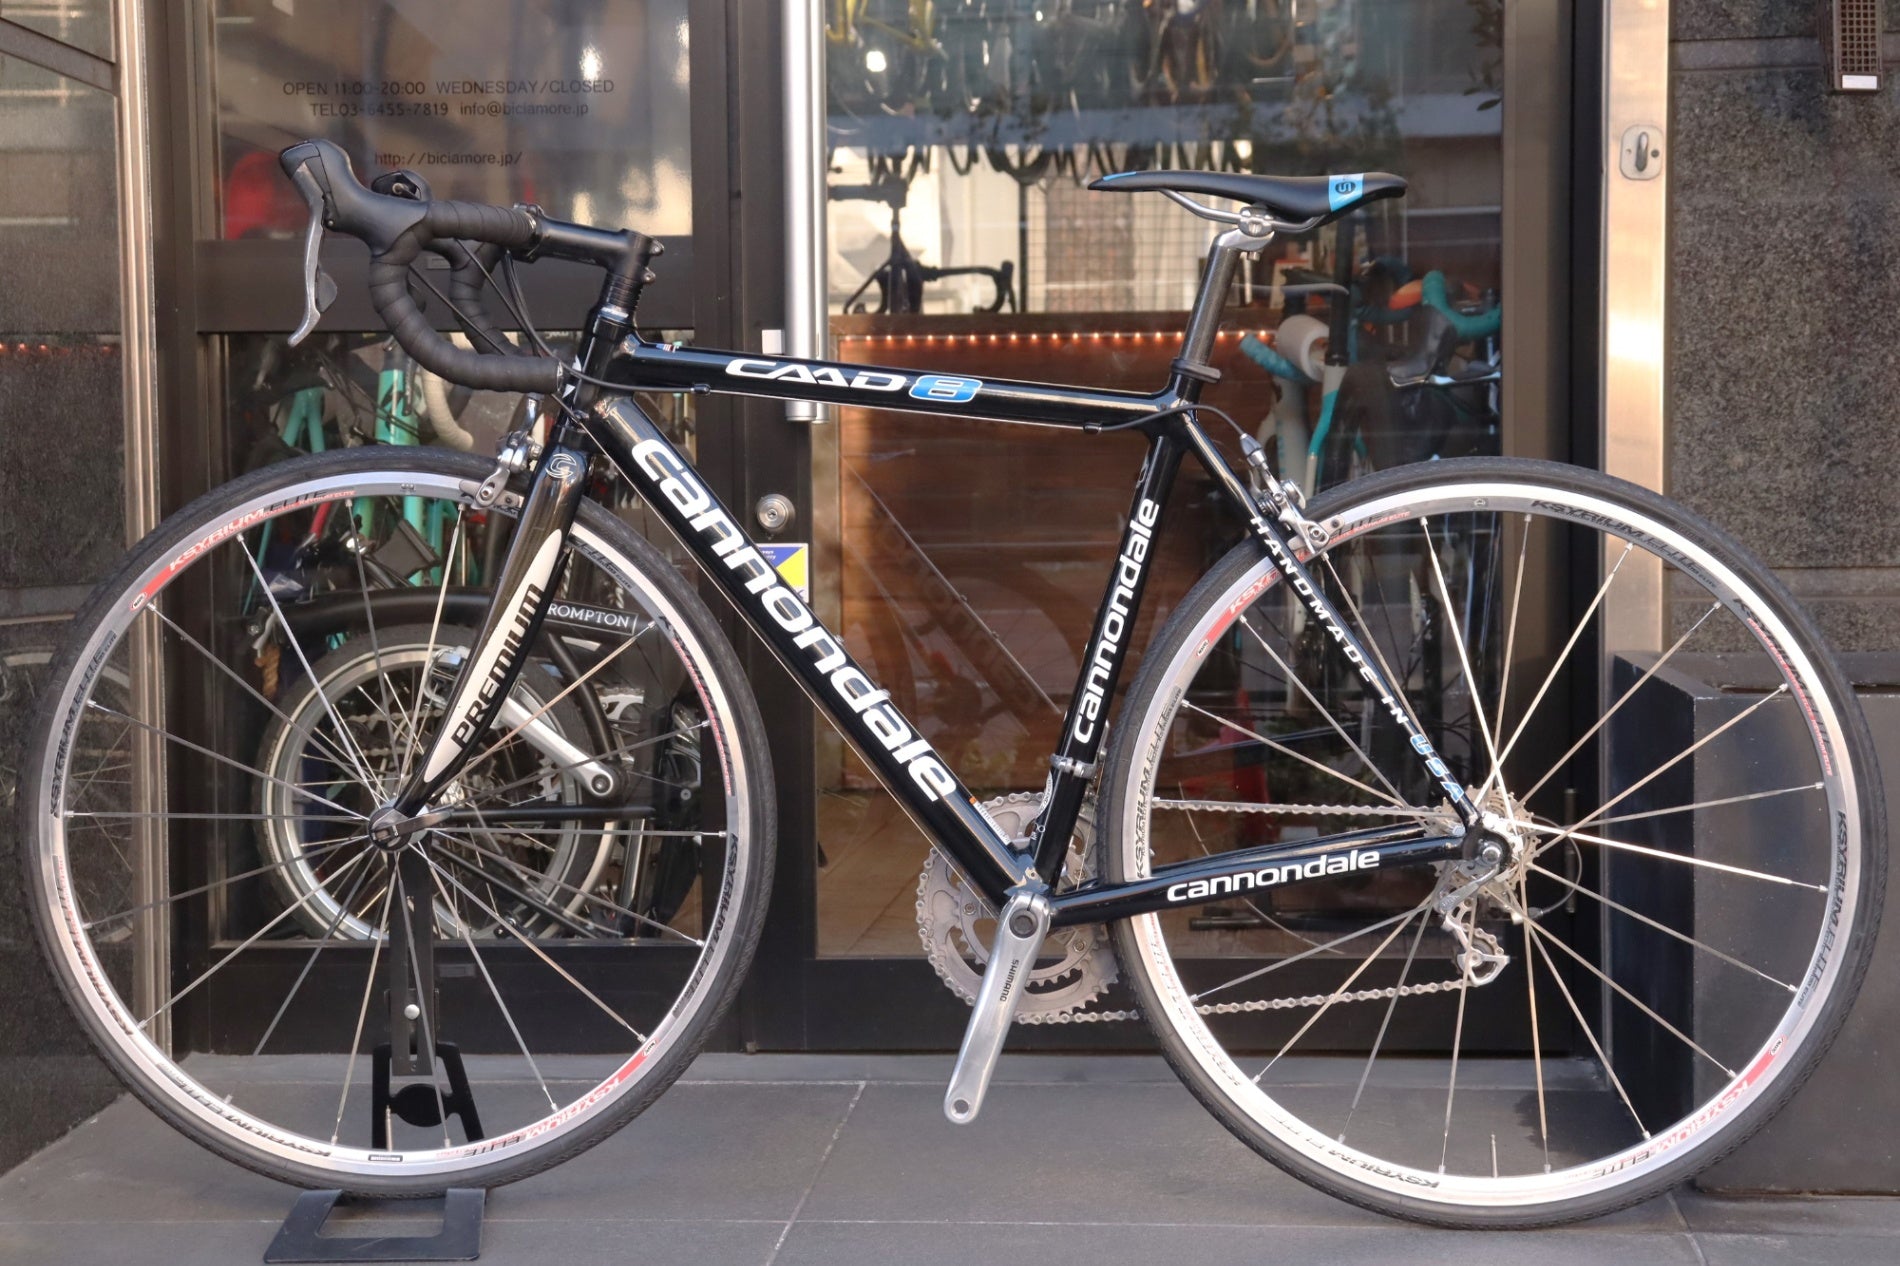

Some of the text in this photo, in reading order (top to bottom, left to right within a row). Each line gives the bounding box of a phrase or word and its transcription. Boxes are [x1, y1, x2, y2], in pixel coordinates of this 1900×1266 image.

[282, 82, 328, 96] OPEN
[436, 79, 615, 95] WEDNESDAY/CLOSED
[460, 102, 589, 117] info@biciamore.jp
[374, 150, 523, 166] http://biciamore.jp/
[547, 603, 630, 628] ROMPTON
[632, 438, 957, 802] cannondale
[1074, 498, 1159, 744] cannondale
[1250, 515, 1464, 804] HANDMADE IN USA
[1167, 848, 1381, 901] cannondale
[1000, 959, 1019, 1001] SHIMANO
